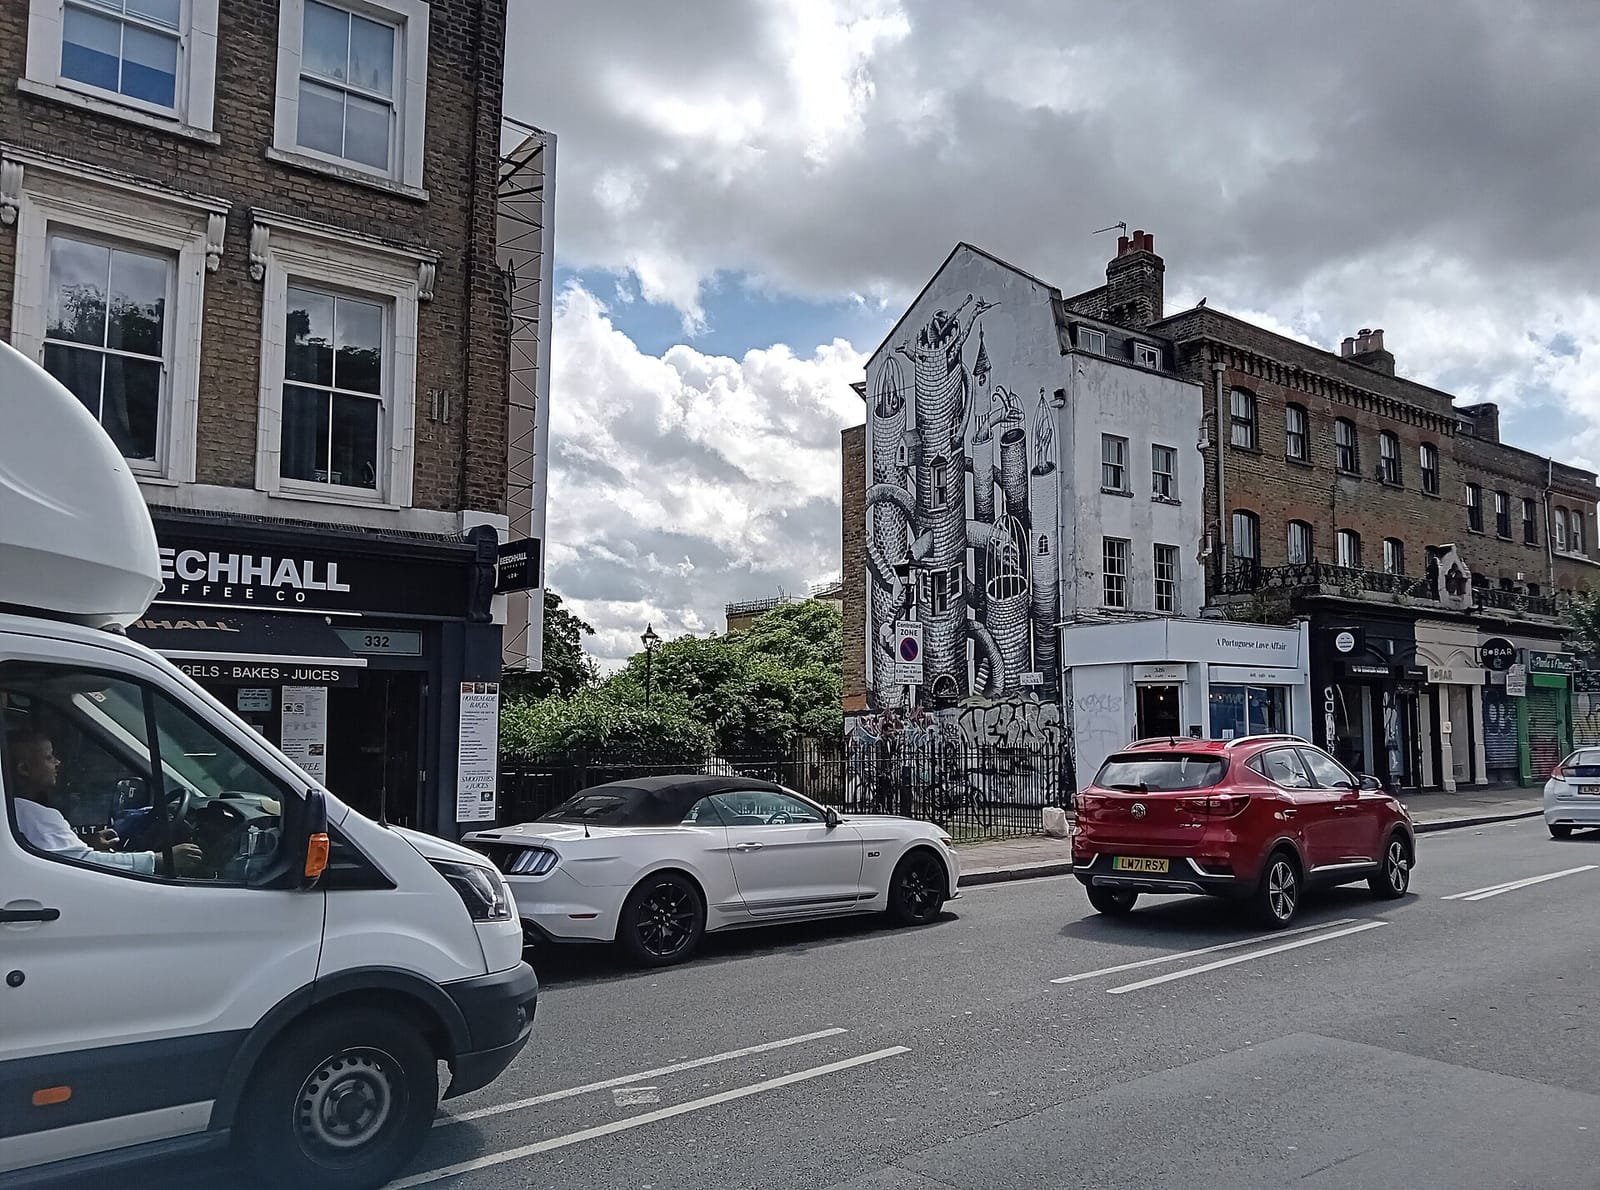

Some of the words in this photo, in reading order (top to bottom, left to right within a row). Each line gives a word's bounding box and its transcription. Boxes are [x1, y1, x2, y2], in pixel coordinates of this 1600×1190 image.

[275, 590, 306, 602] CO
[900, 628, 918, 637] ZONE
[365, 635, 390, 648] 332
[1221, 638, 1255, 650] Portuguese
[1255, 640, 1270, 650] Love
[1271, 642, 1288, 651] Affair
[176, 664, 220, 678] GELS
[232, 666, 280, 679] BAKES
[291, 668, 340, 681] JUICES
[1145, 860, 1166, 871] RSX
